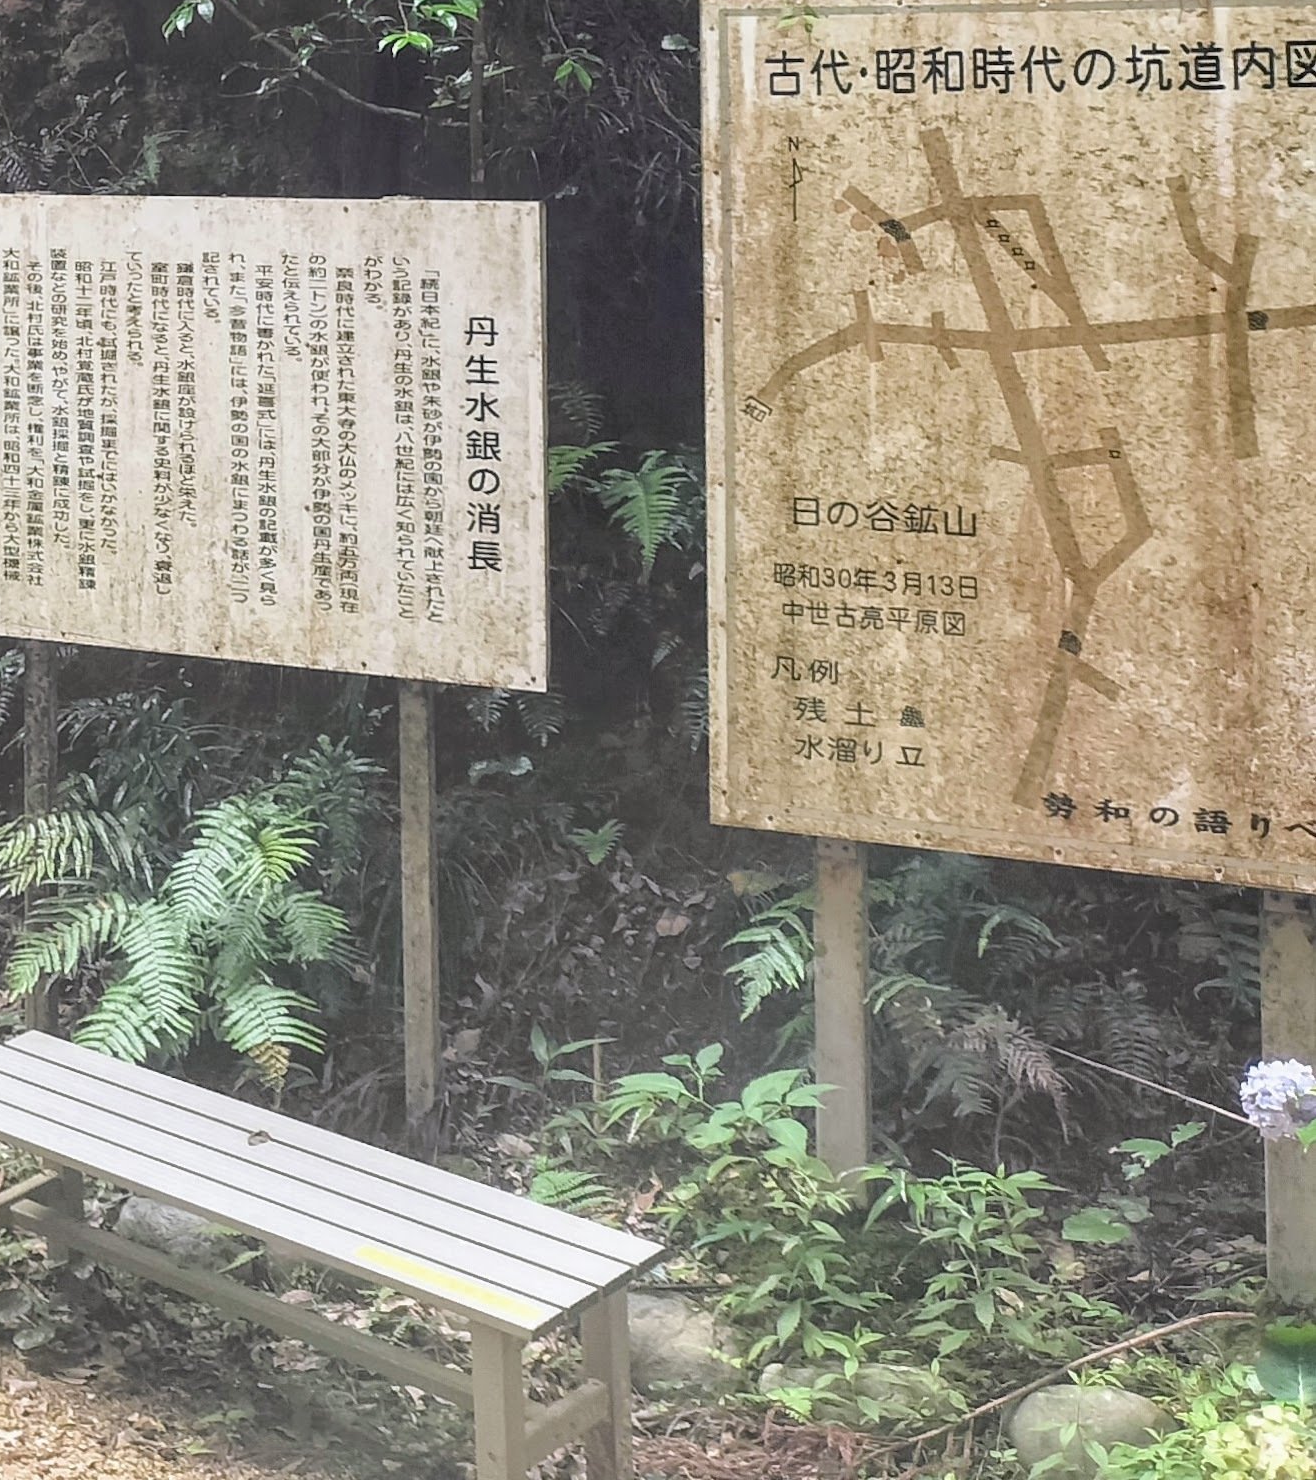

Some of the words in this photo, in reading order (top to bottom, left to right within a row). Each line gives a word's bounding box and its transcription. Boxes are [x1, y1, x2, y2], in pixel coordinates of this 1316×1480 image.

[787, 136, 799, 151] N
[464, 316, 502, 573] 丹生水銀の消長
[792, 496, 978, 538] 日の谷鉱山
[773, 562, 979, 600] 昭和30年3月13日
[781, 599, 966, 637] 中世古亮平原図
[770, 655, 840, 686] 凡例
[794, 733, 884, 765] 水溜り
